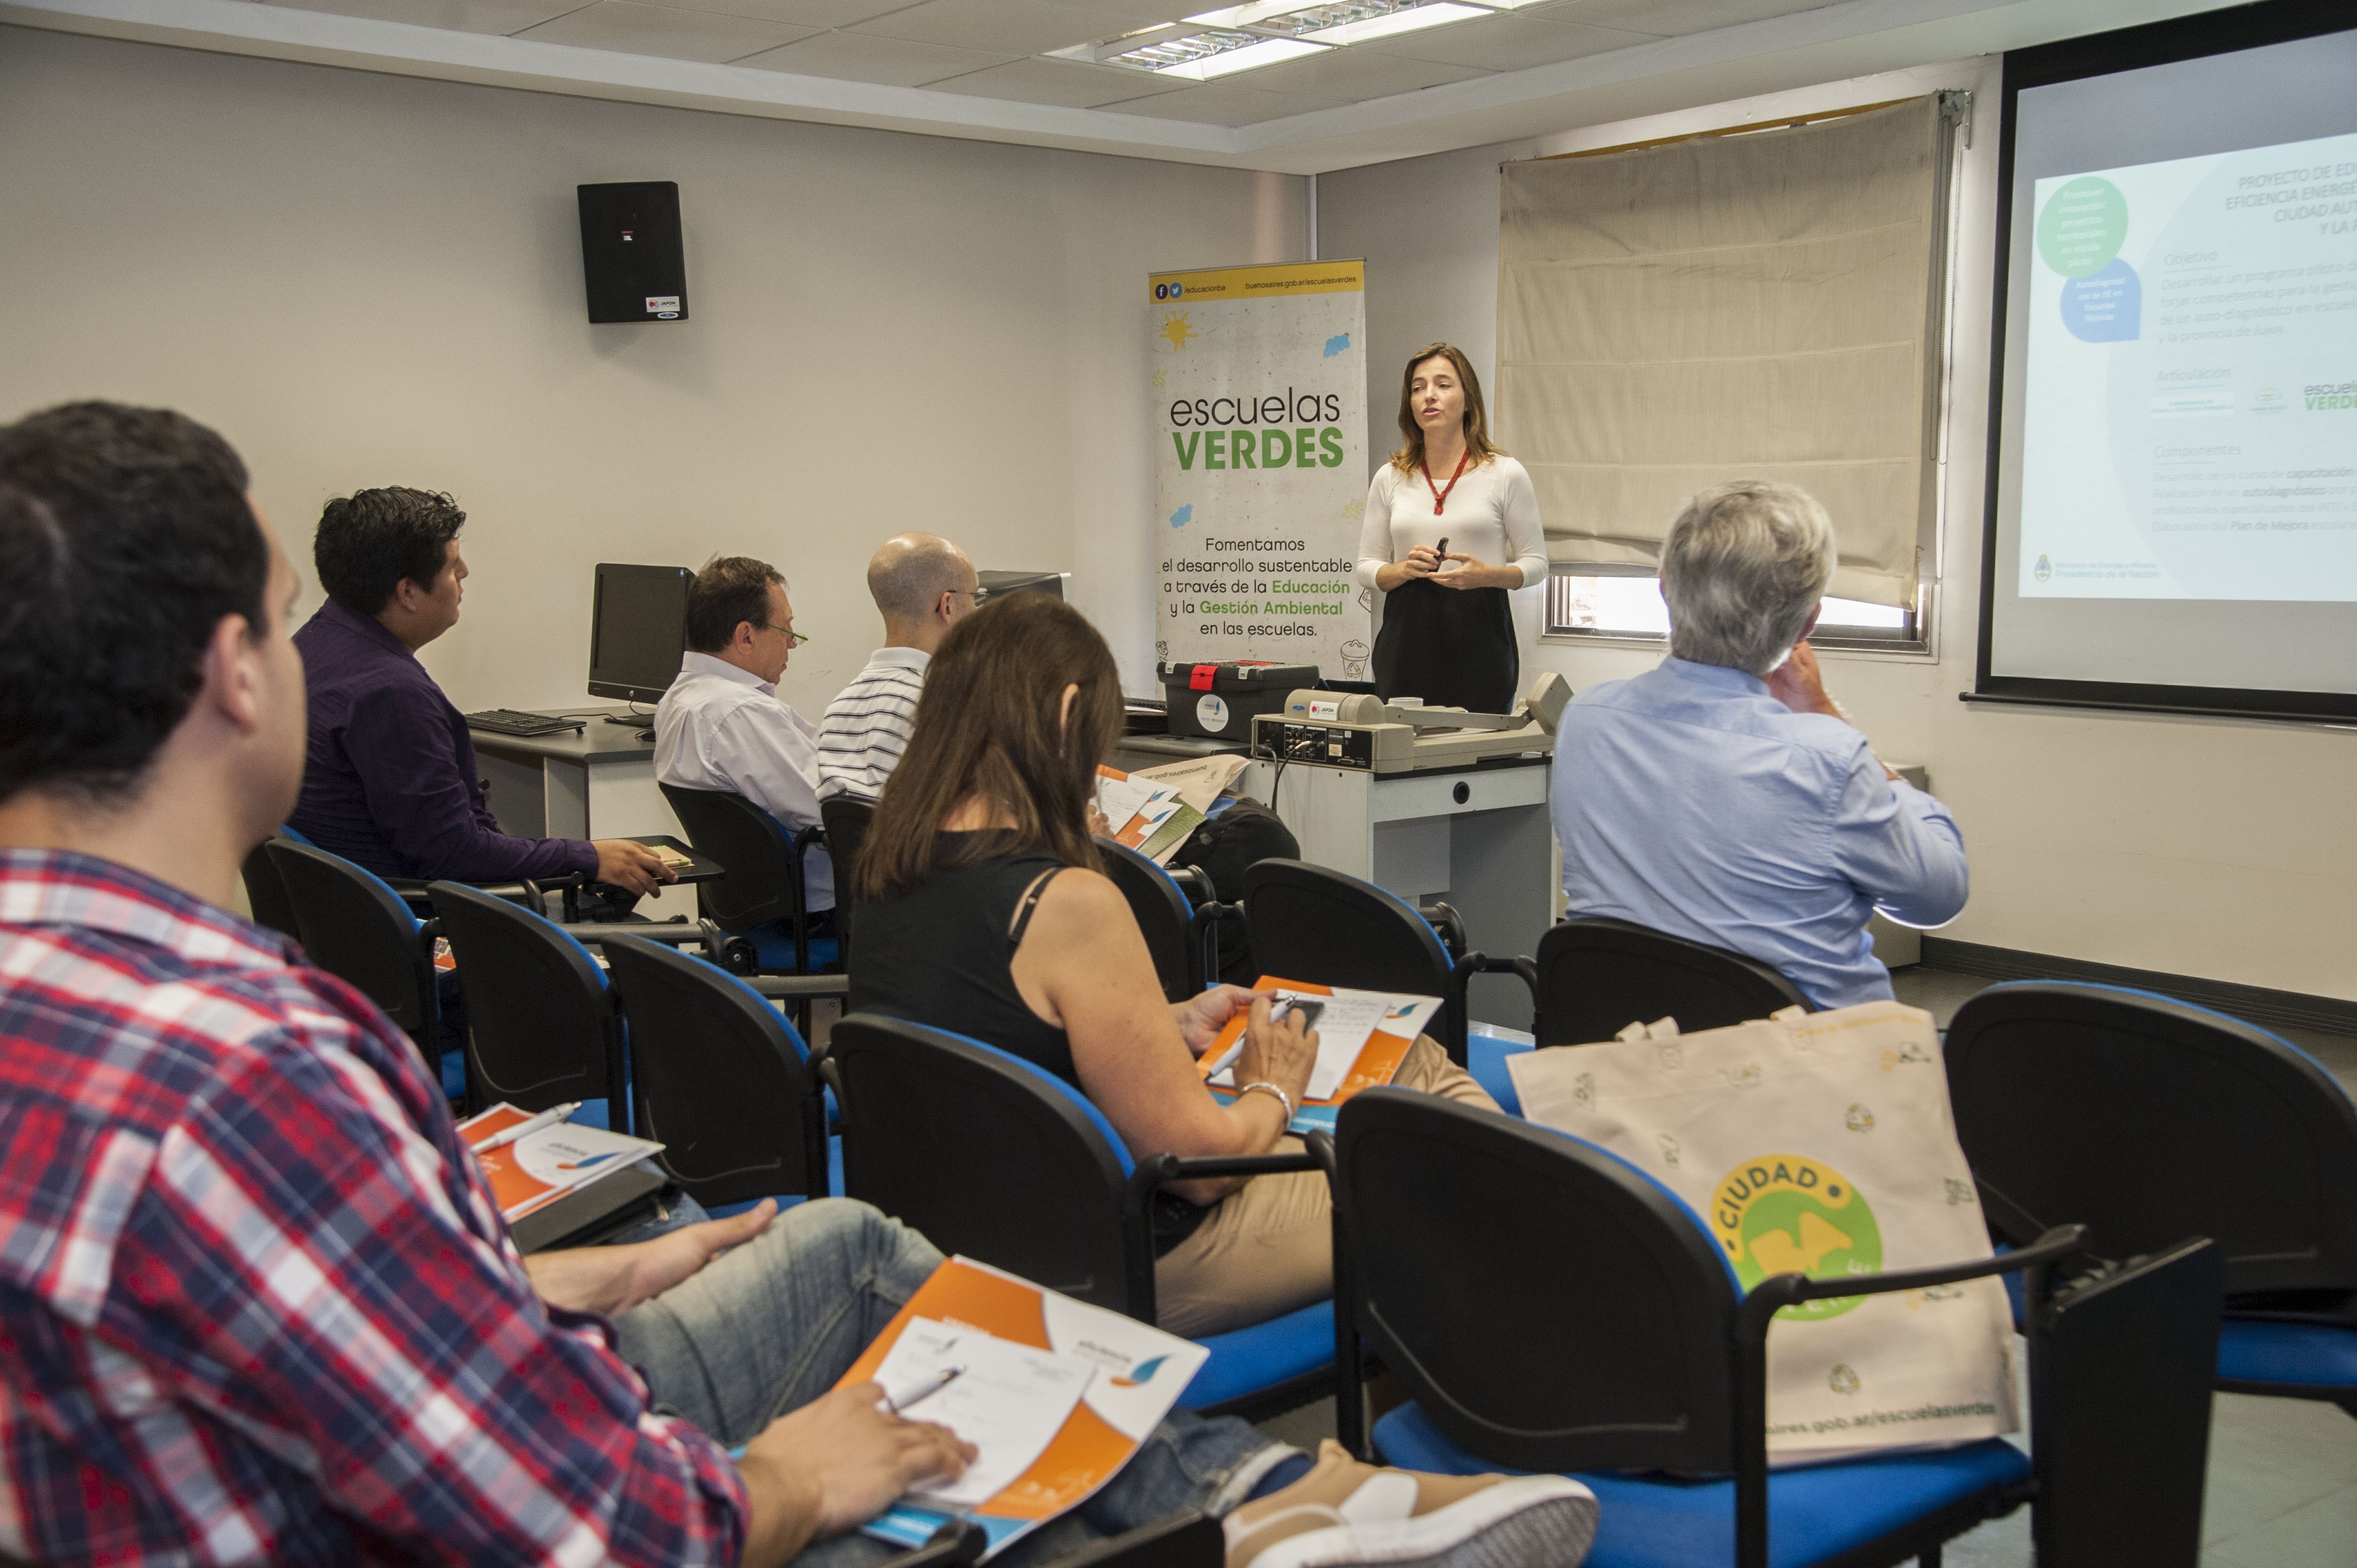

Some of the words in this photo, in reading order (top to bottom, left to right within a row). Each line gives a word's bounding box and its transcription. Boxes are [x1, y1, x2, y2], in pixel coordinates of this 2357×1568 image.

[2239, 169, 2310, 189] PROYECTO
[2313, 166, 2332, 180] DE
[2225, 189, 2298, 210] EFICIENCIA
[2274, 204, 2328, 222] CIUDAD
[2319, 222, 2329, 235] Y
[2332, 220, 2349, 234] LA
[2164, 251, 2217, 267] Objetivo
[2227, 275, 2242, 284] un
[2245, 267, 2304, 283] programa
[2308, 262, 2344, 277] piloto
[1184, 285, 1226, 293] /educacionba
[1246, 276, 1356, 290] buenosaires.gob.ar/escuelasverdes
[2193, 288, 2274, 305] competencias
[2278, 285, 2305, 299] para
[2309, 282, 2319, 294] la
[2296, 303, 2311, 314] en
[2156, 367, 2231, 383] Articulación
[1170, 386, 1340, 427] escuelas
[1172, 427, 1344, 471] VERDES
[2154, 445, 2242, 459] Componentes
[2207, 470, 2220, 480] de
[2230, 520, 2252, 531] Plan
[2255, 520, 2268, 530] de
[2271, 520, 2309, 533] Mejora
[1206, 538, 1305, 551] Fomentamos
[1162, 559, 1172, 572] el
[1177, 558, 1253, 572] desarrollo
[1258, 558, 1352, 572] sustentable
[1164, 583, 1171, 593] a
[1176, 579, 1227, 593] través
[1231, 580, 1249, 593] de
[1254, 579, 1267, 593] la
[1273, 580, 1350, 594] Educación
[1170, 604, 1177, 617] y
[1183, 600, 1195, 613] la
[1200, 600, 1258, 614] Gestión
[1264, 601, 1342, 615] Ambiental
[1200, 624, 1218, 635] en
[1223, 621, 1243, 636] las
[1248, 622, 1317, 636] escuelas.
[1719, 1162, 1818, 1229] CIUDAD
